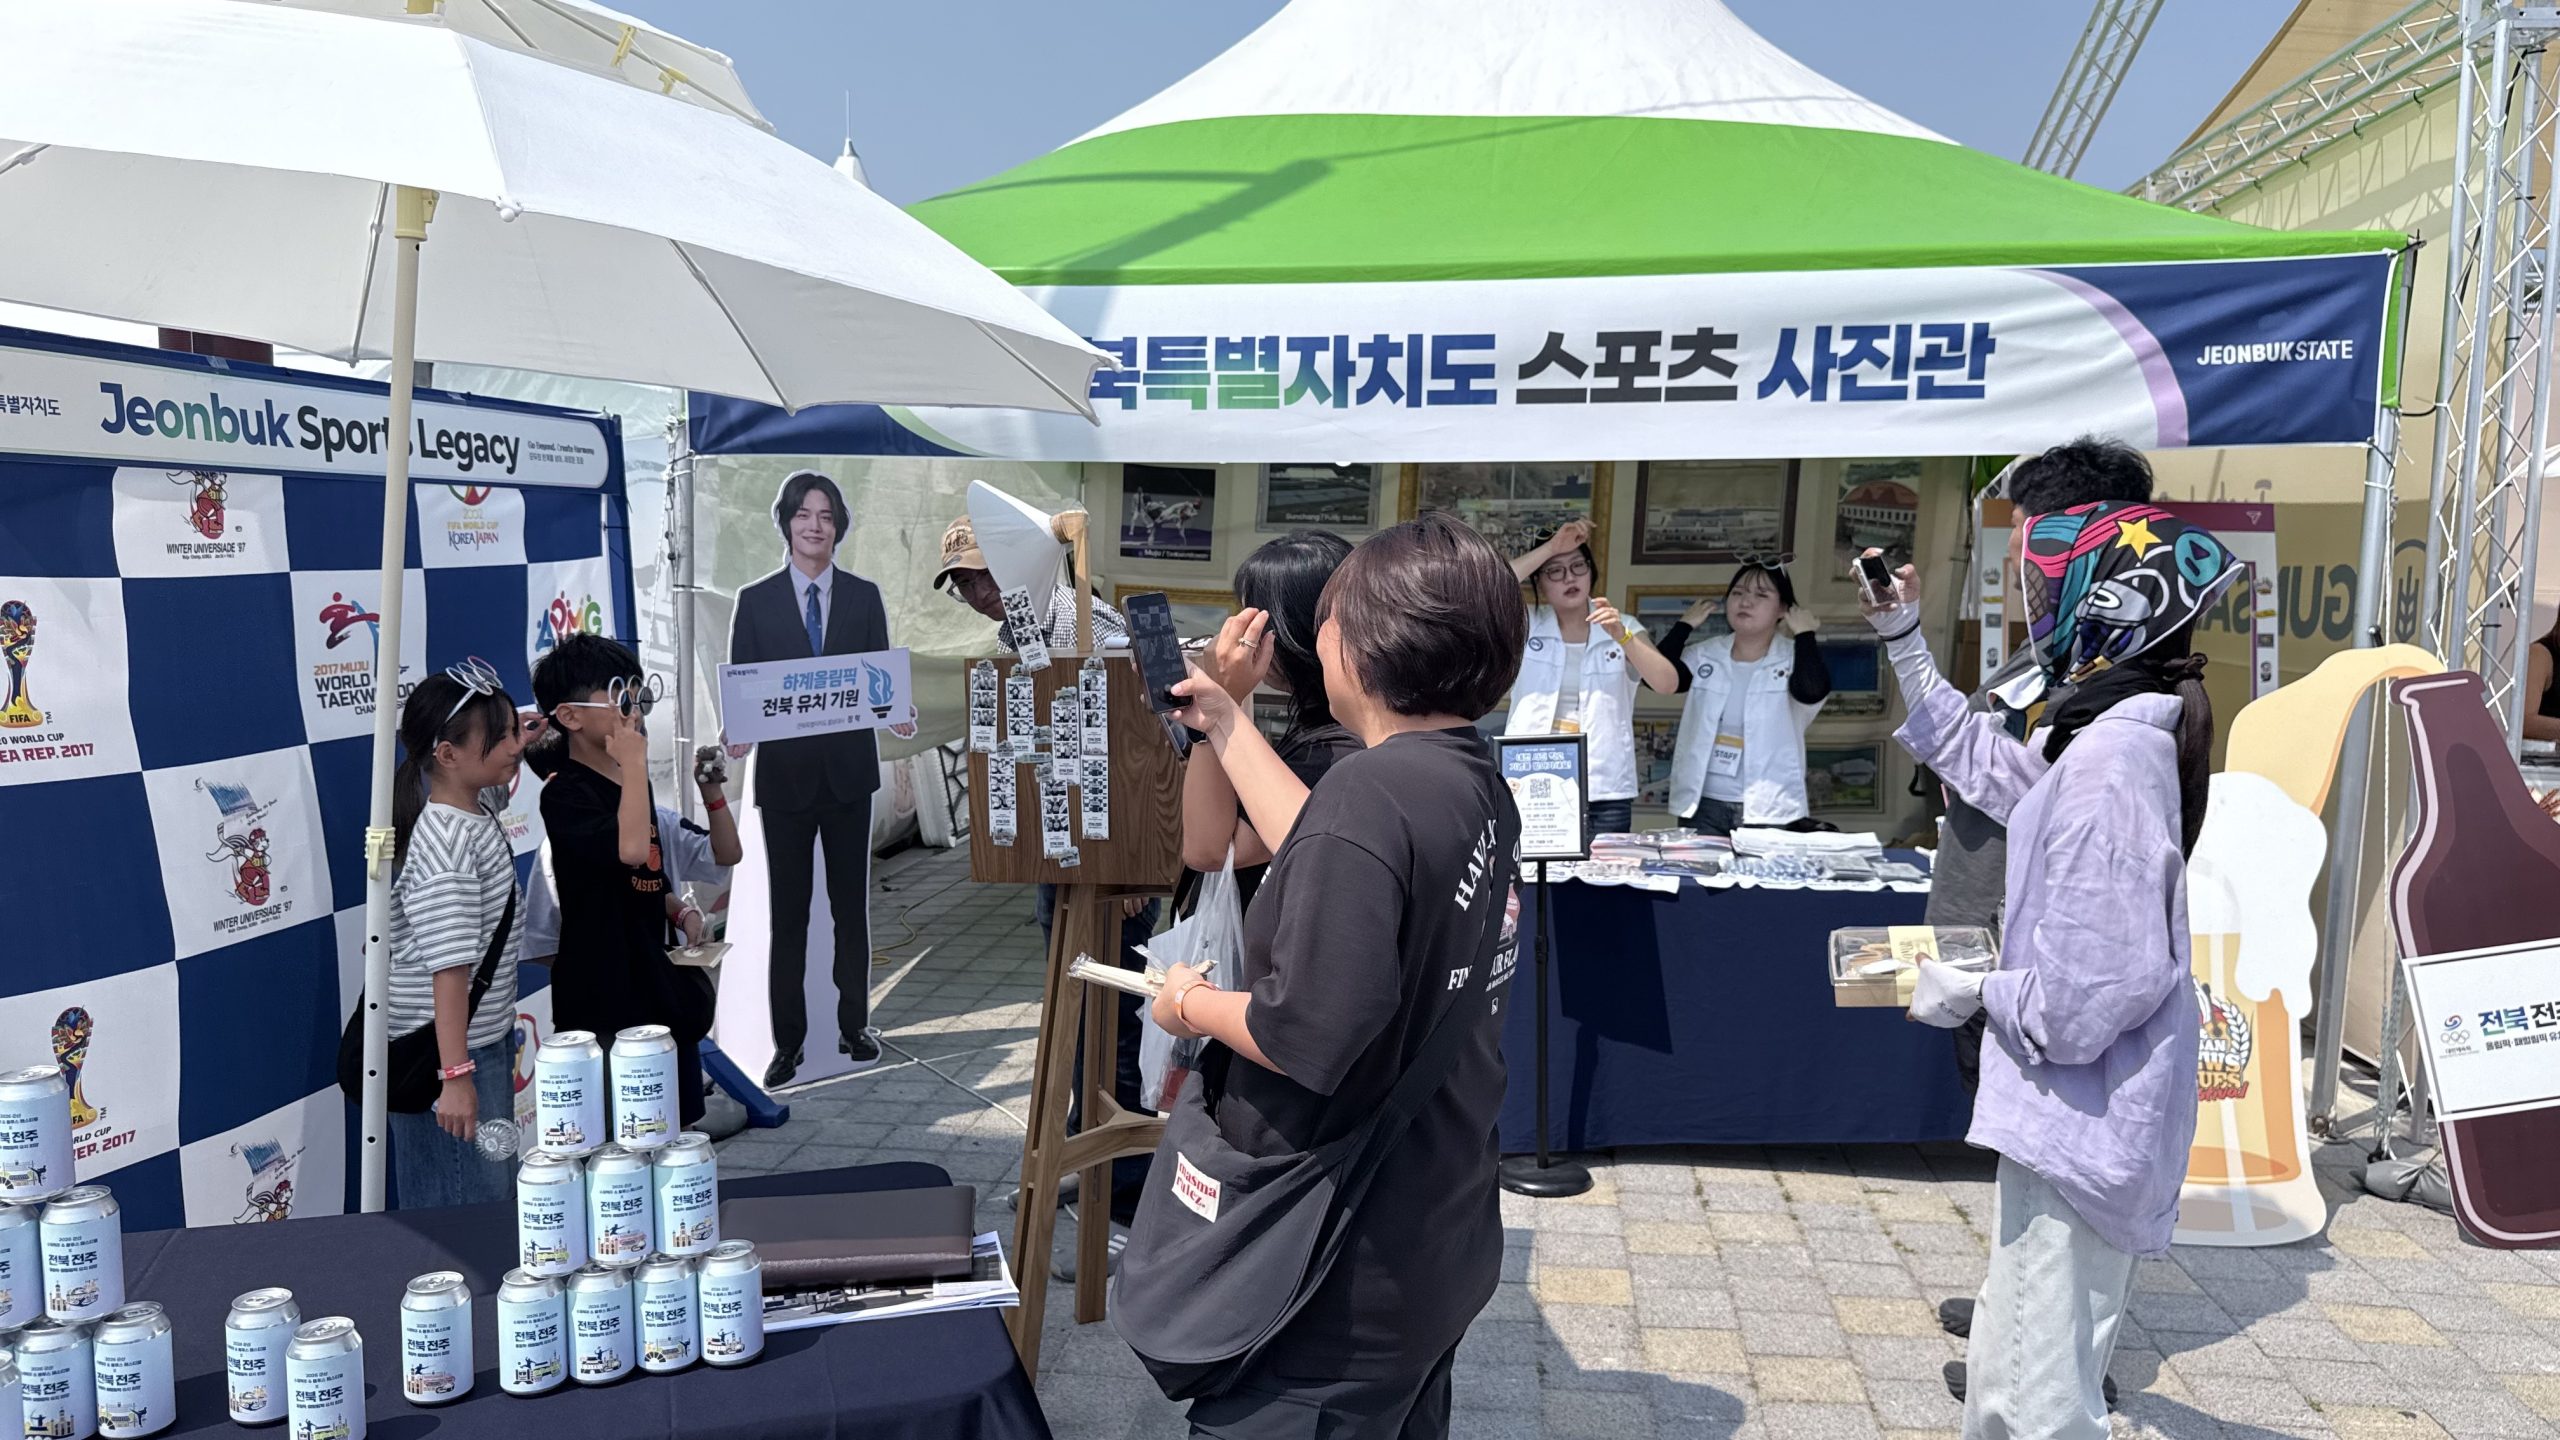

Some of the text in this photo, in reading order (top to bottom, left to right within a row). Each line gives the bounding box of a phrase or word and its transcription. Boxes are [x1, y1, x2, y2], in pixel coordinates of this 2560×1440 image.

[1515, 326, 1739, 404] 스포츠
[1757, 322, 1995, 402] 사진관
[100, 381, 295, 448] Jeonbuk
[417, 418, 520, 475] Legacy
[462, 521, 485, 530] WORLD
[485, 521, 499, 530] CUP
[166, 542, 193, 555] WINTER
[193, 542, 236, 555] UNIVERSIADE
[313, 660, 369, 676] 2017 MUJU
[314, 673, 371, 692] WORLD
[783, 667, 858, 691] 하계올림픽
[316, 682, 416, 709] TAEKWDO
[762, 688, 860, 717] 전북 유치 기원
[9, 714, 31, 723] FIFA
[9, 733, 45, 745] WORLD
[47, 732, 65, 742] CUP
[21, 746, 60, 761] REP.
[61, 743, 94, 758] 2017
[1714, 749, 1739, 761] STAFF
[213, 917, 239, 933] WINTER
[240, 906, 282, 925] UNIVERSIADE
[2477, 1001, 2560, 1036] 전북 전
[541, 1089, 582, 1102] 전북 전주
[621, 1083, 663, 1096] 전북 전주
[12, 1129, 39, 1143] 전주
[94, 1126, 112, 1138] CUP
[102, 1130, 136, 1151] 2017
[600, 1197, 643, 1212] 전북 전주
[672, 1189, 712, 1207] 전북 전주
[523, 1212, 565, 1225] 전북 전주
[48, 1250, 98, 1267] 전북 전주
[645, 1306, 687, 1321] 전북 전주
[703, 1300, 742, 1314] 전북 전주
[577, 1316, 620, 1332] 전북 전주
[514, 1324, 558, 1342] 전북 전주
[407, 1338, 450, 1351] 전북 전주
[243, 1358, 266, 1371] 전주
[97, 1372, 141, 1386] 전북 전주
[22, 1380, 69, 1395] 전북 전주
[295, 1386, 344, 1402] 전북 전주
